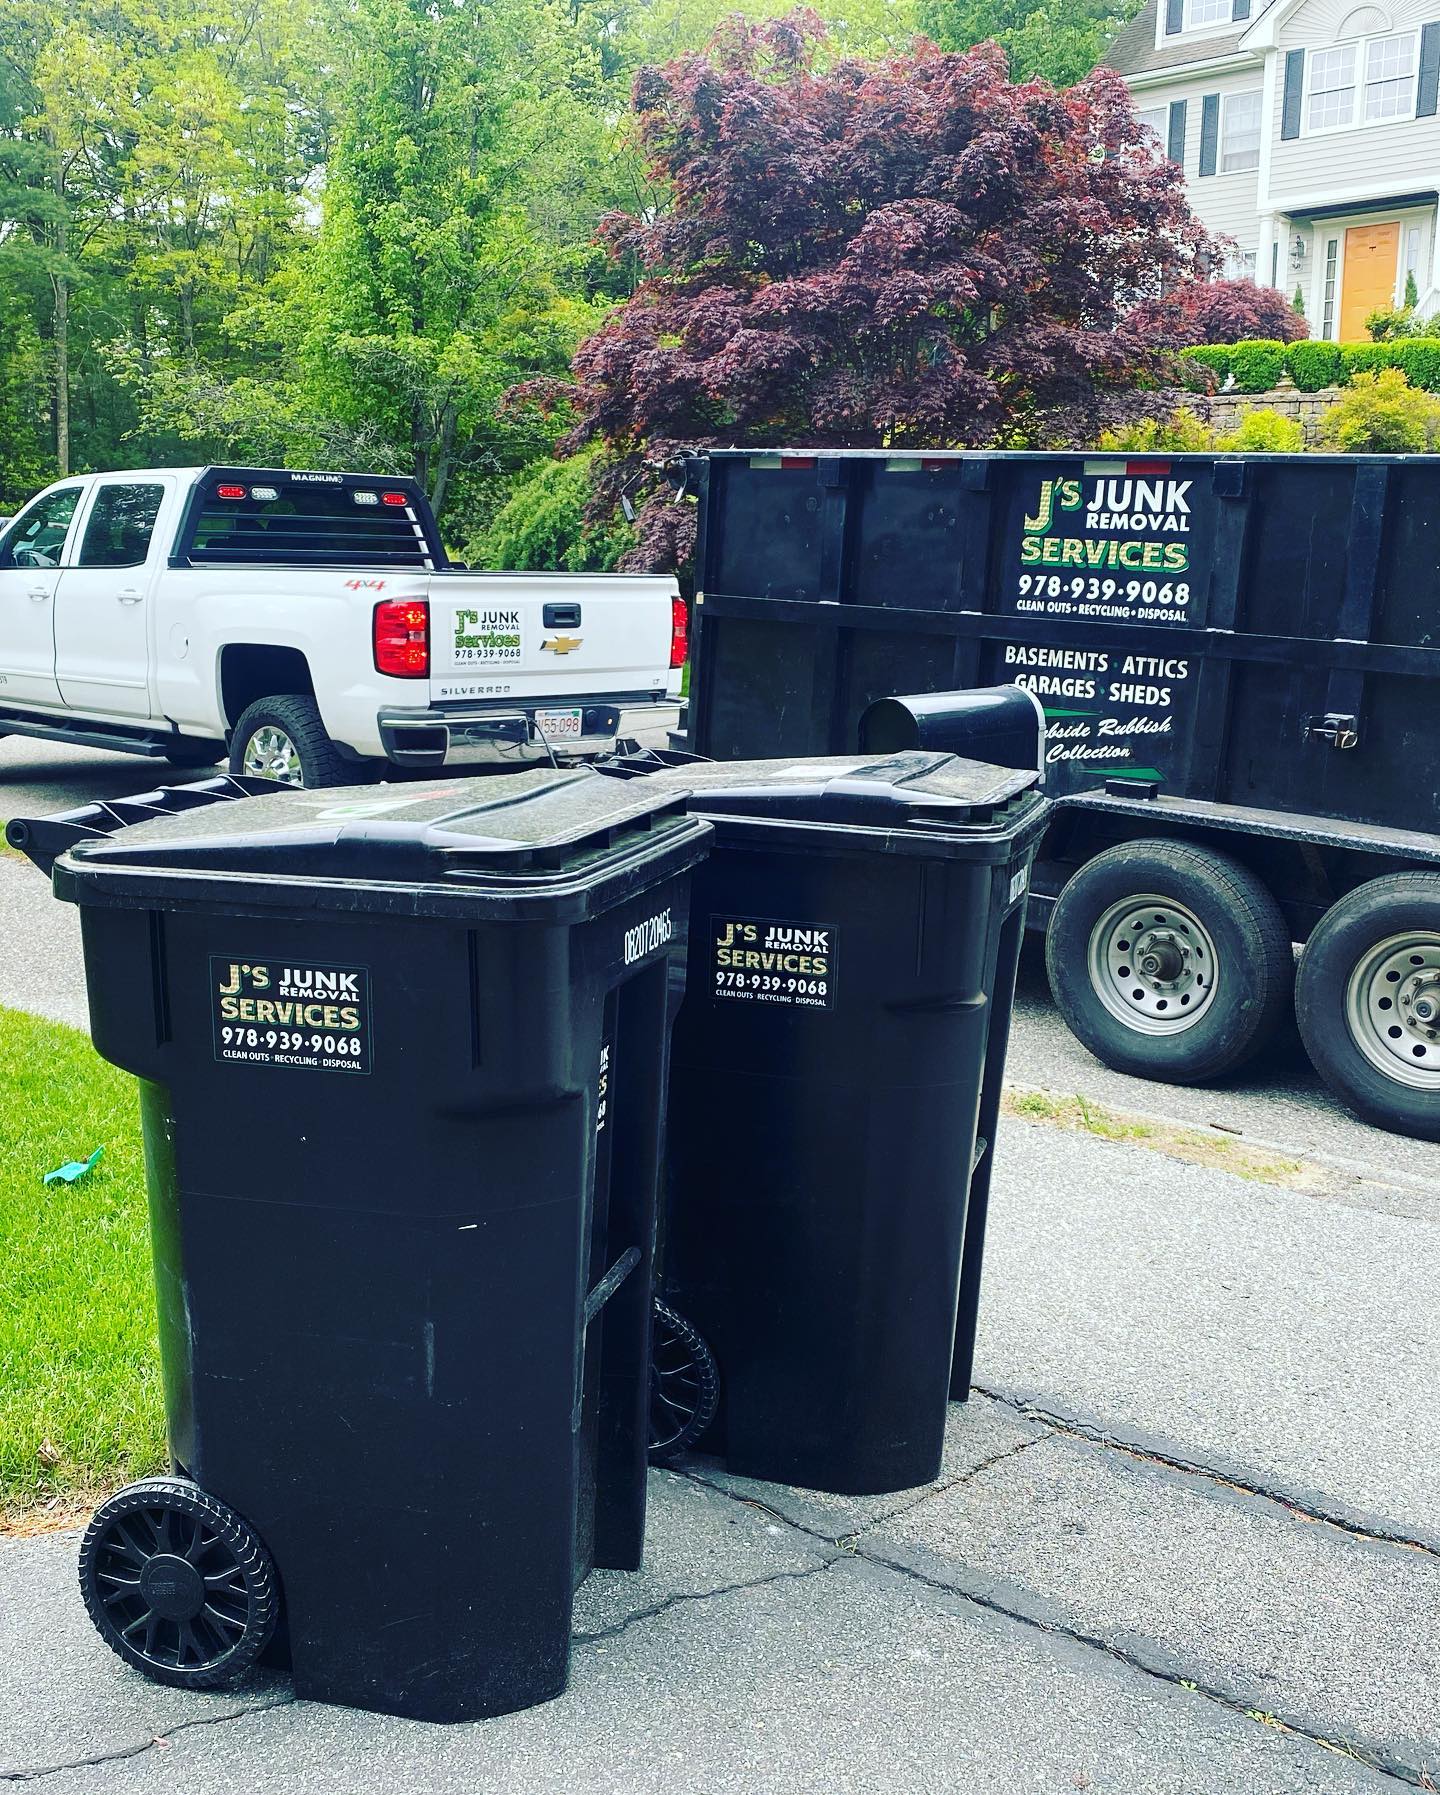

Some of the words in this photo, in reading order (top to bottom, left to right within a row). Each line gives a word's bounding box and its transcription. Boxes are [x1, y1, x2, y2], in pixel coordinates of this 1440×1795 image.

[291, 474, 338, 482] MAGNUM
[1024, 476, 1082, 534] J'S
[1086, 480, 1193, 513] JUNK
[1086, 512, 1190, 532] REMOVAL
[1020, 537, 1190, 573] SERVICES
[481, 611, 520, 624] JUNK
[1016, 600, 1045, 612] CLEAN
[1047, 602, 1072, 614] OUTS
[1078, 603, 1130, 618] RECYCLING
[1138, 608, 1187, 622] DISPOSAL
[455, 631, 520, 649] services
[1004, 646, 1109, 672] BASEMENTS
[1122, 656, 1188, 679] ATTICS
[441, 685, 511, 696] SILVERADO
[1015, 674, 1096, 699] GARAGES
[1109, 682, 1171, 706] SHEDS
[1098, 716, 1173, 737] Rubbish
[1046, 743, 1131, 763] Collection
[716, 923, 757, 947] J'S
[765, 927, 829, 946] JUNK
[765, 941, 829, 954] REMOVAL
[717, 948, 828, 975] SERVICES
[219, 964, 271, 996] J'S
[279, 968, 360, 992] JUNK
[279, 987, 360, 1002] REMOVAL
[715, 989, 735, 998] CLEAN
[736, 991, 753, 999] OUTS
[757, 993, 792, 1003] RECYCLING
[795, 997, 827, 1007] DISPOSAL
[220, 996, 361, 1031] SERVICES
[223, 1050, 248, 1060] CLEAN
[249, 1051, 270, 1062] OUTS
[275, 1054, 318, 1066] RECYCLING
[323, 1058, 362, 1070] DISPOSAL
